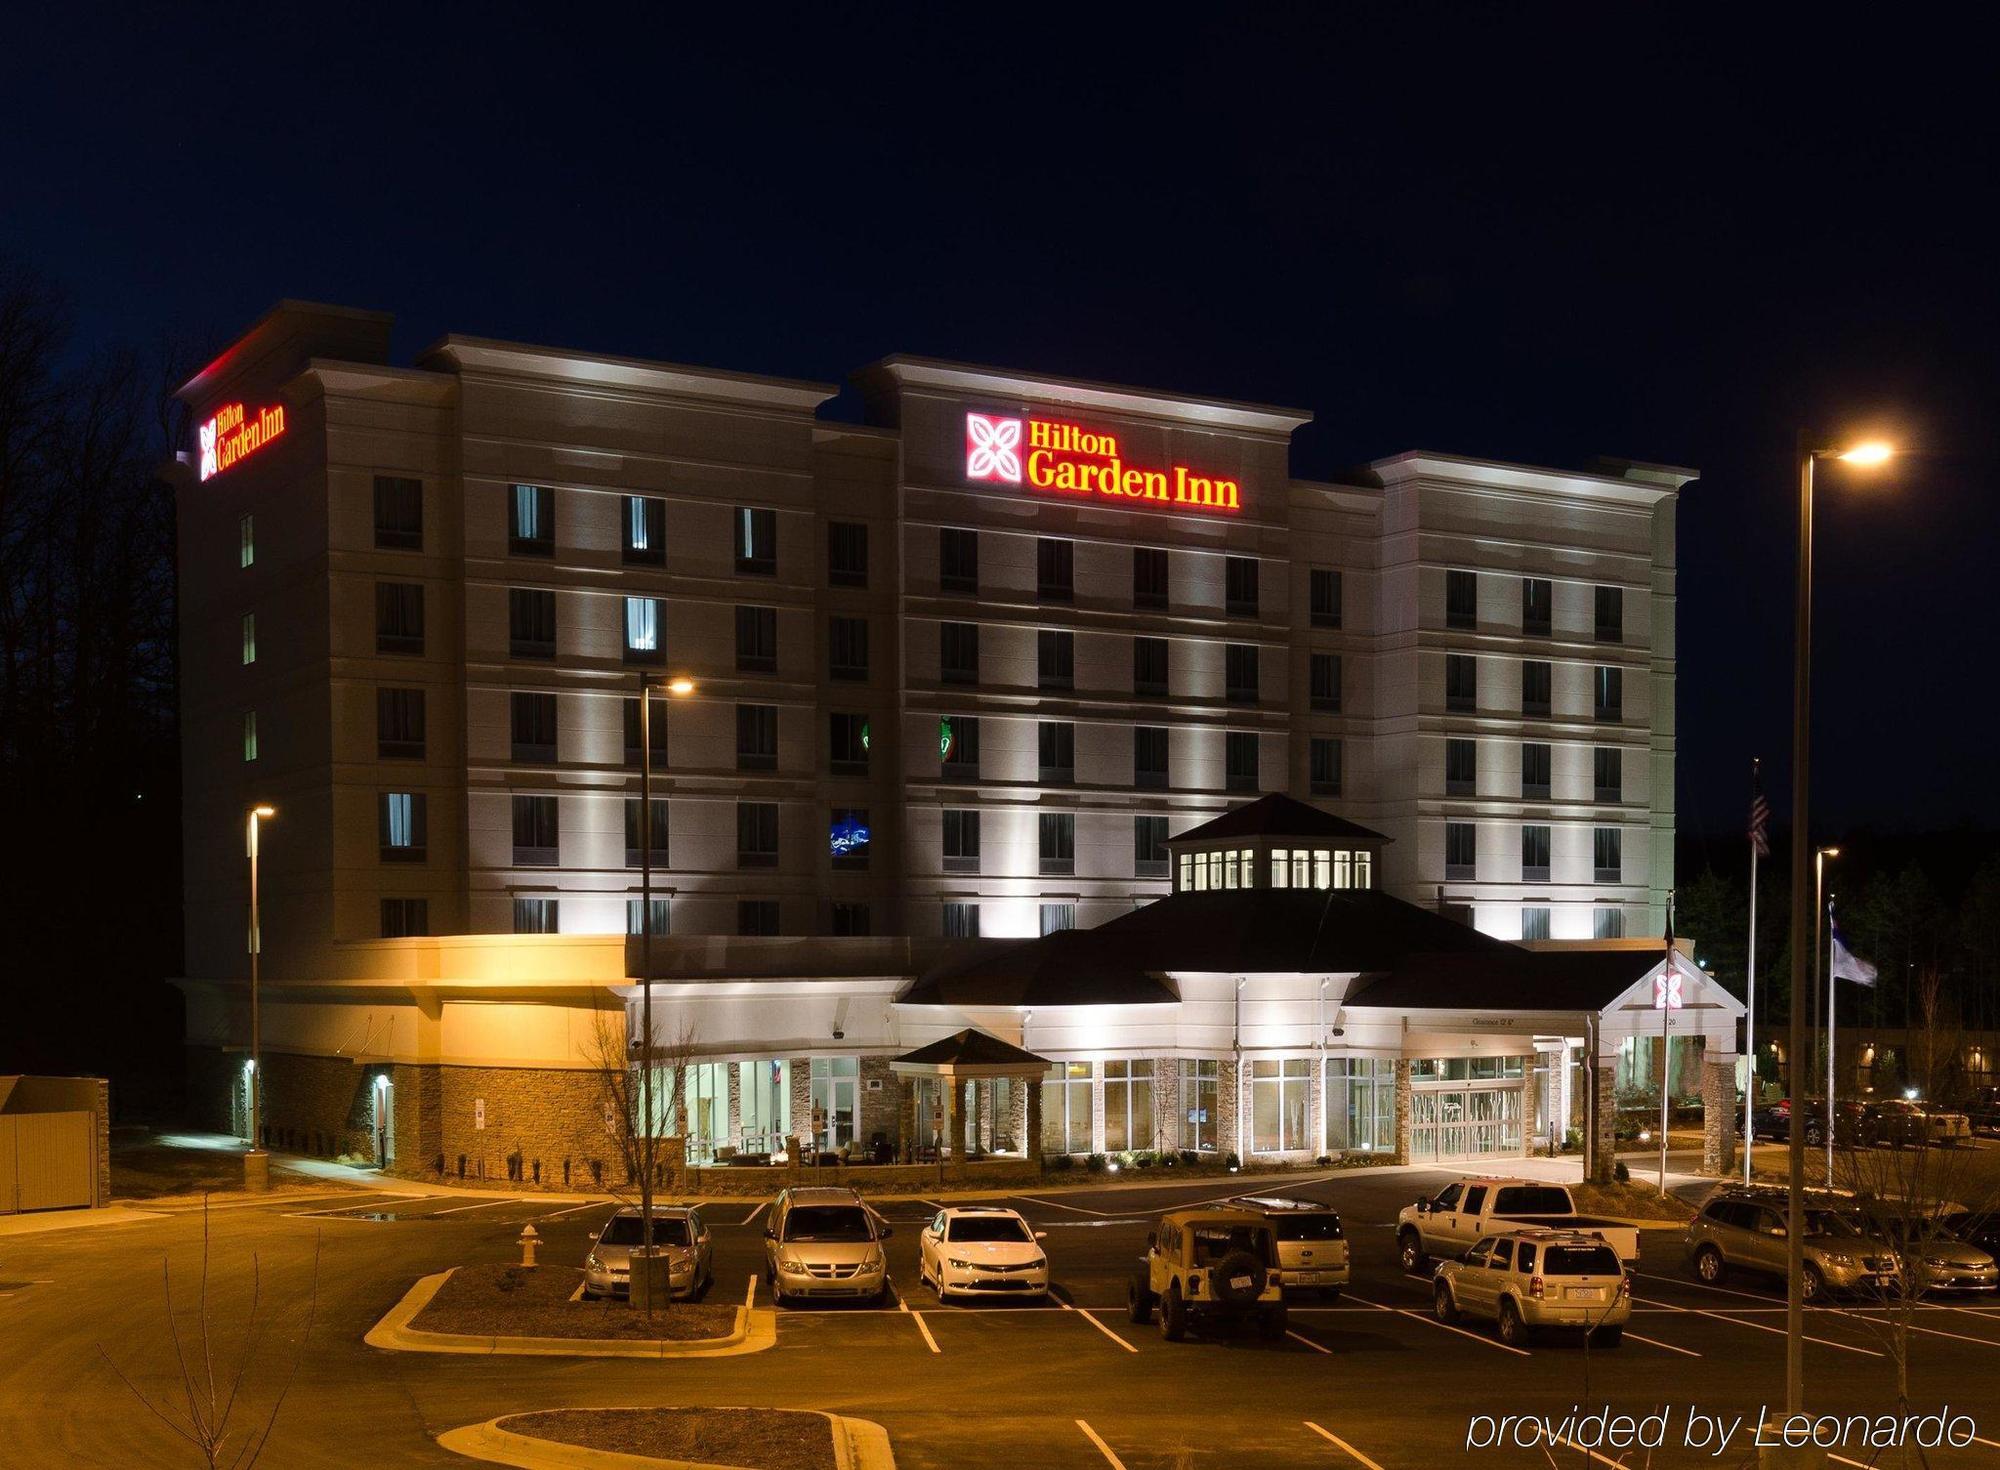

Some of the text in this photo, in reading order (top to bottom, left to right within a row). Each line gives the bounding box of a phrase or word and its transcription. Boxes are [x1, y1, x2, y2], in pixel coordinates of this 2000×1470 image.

[217, 403, 243, 435] Hilton
[217, 405, 285, 471] Garden Inn
[1028, 420, 1118, 457] Hilton
[1027, 450, 1240, 508] Garden Inn
